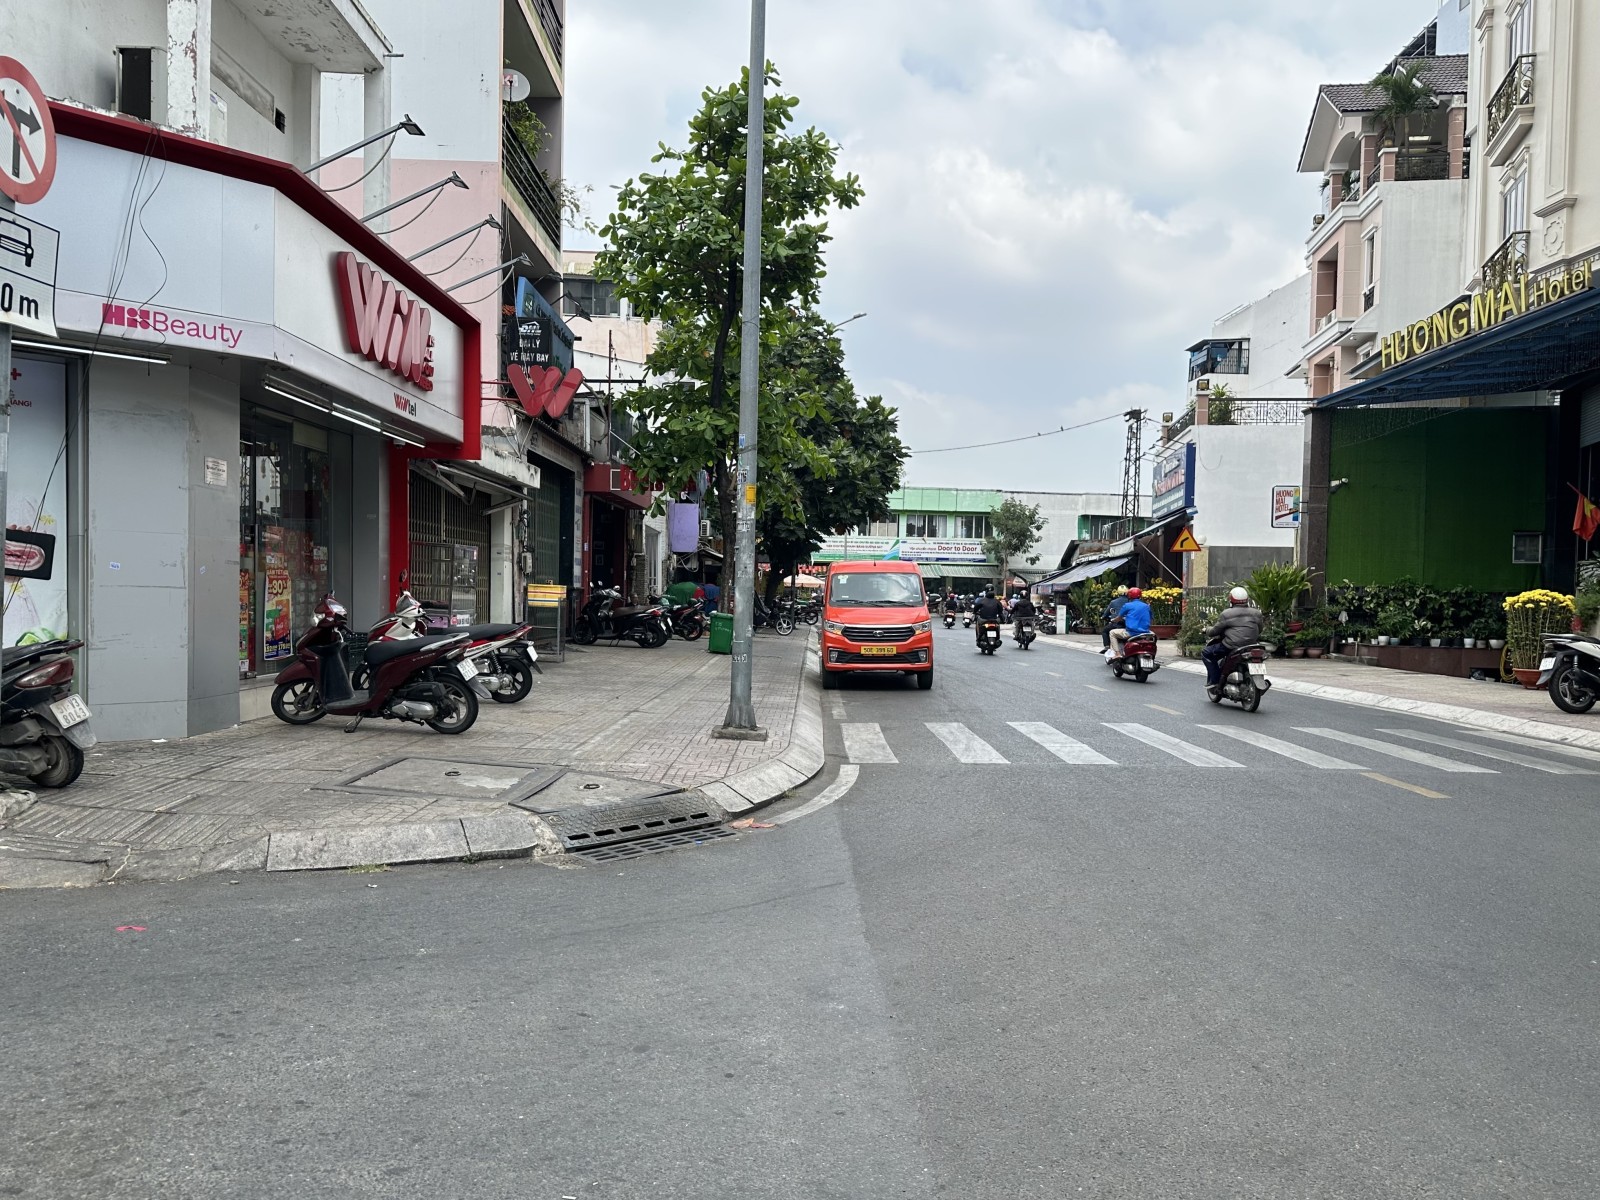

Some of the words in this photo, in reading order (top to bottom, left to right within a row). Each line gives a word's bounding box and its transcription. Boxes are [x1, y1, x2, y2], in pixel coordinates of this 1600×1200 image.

[1474, 272, 1530, 332] MAI
[1533, 257, 1593, 308] Hotel
[536, 353, 549, 362] BAY
